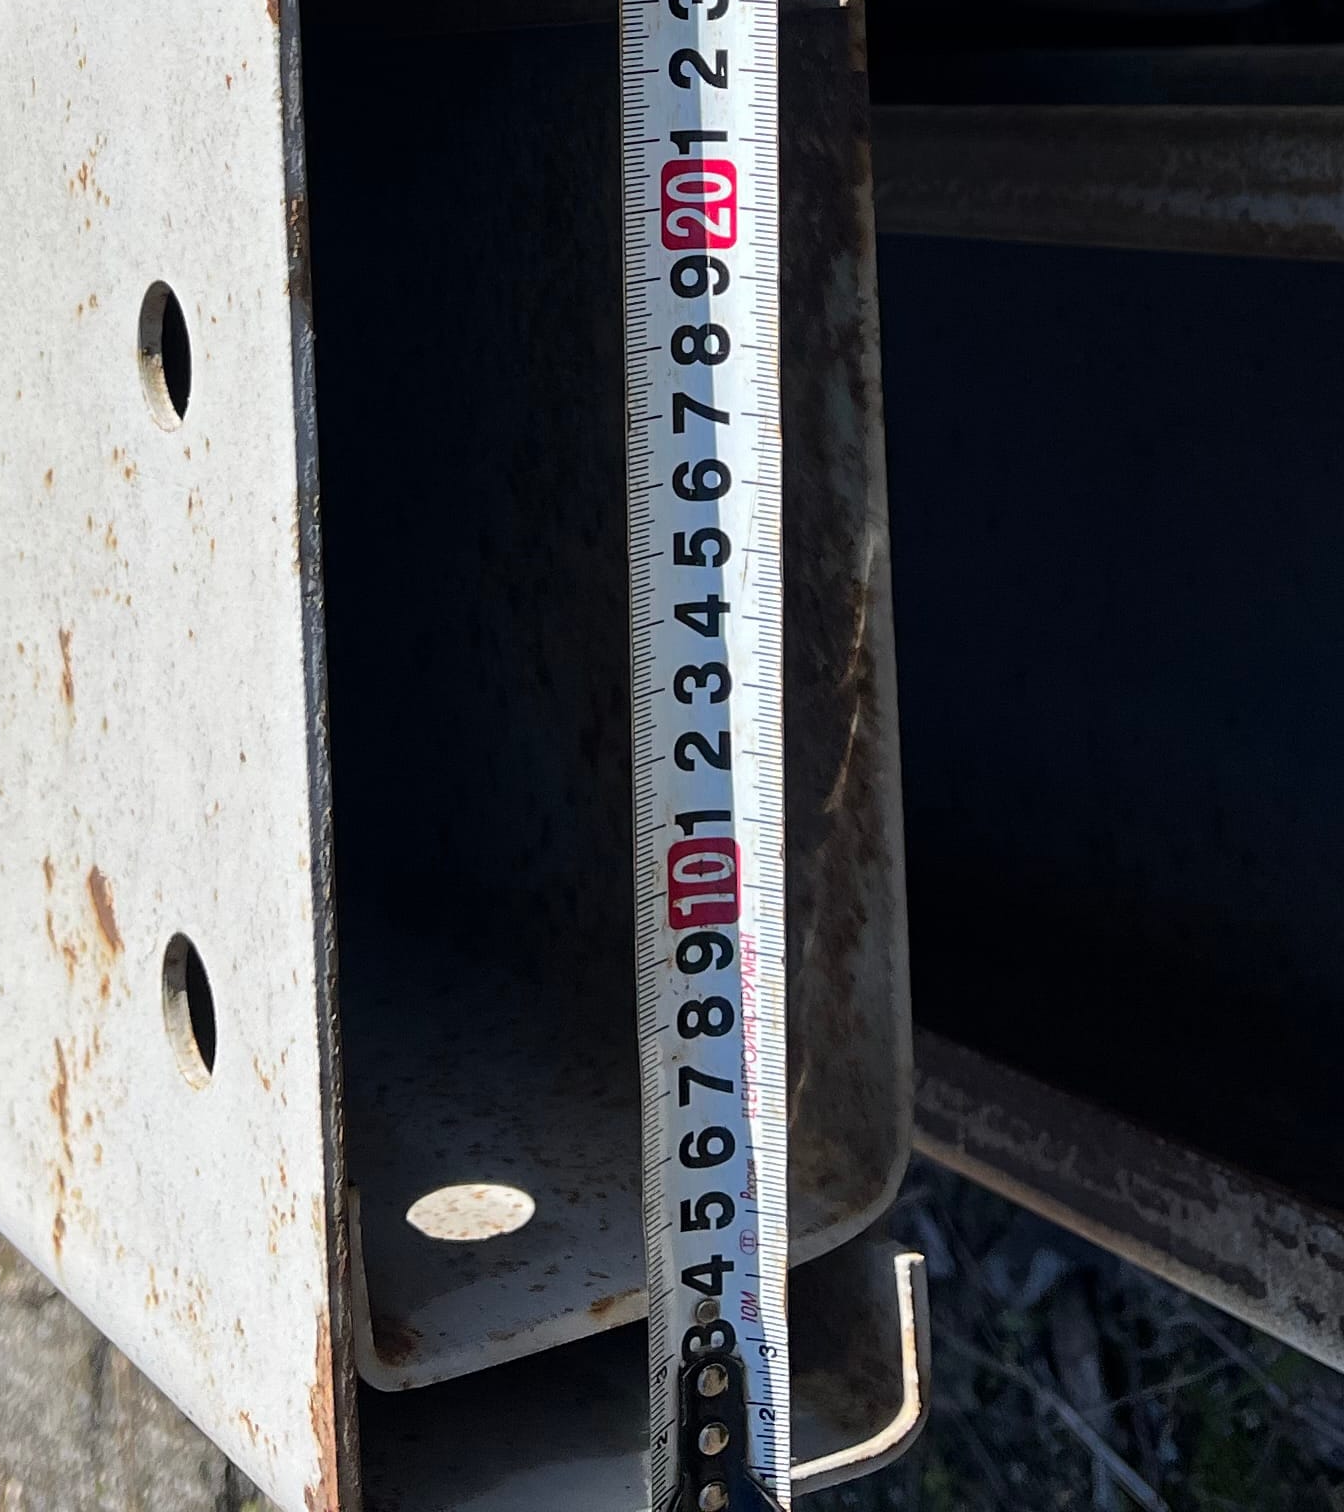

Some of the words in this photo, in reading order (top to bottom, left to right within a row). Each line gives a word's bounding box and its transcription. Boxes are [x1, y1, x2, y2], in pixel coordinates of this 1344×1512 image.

[669, 48, 729, 90] 2
[669, 128, 728, 155] 1
[666, 171, 731, 240] 20
[669, 254, 730, 297] 9
[670, 323, 731, 366] 8
[672, 392, 731, 434] 7
[672, 457, 733, 502] 6
[673, 526, 733, 567] 5
[674, 594, 732, 637] 4
[673, 660, 733, 705] 3
[674, 730, 732, 772] 2
[675, 809, 732, 837] 1
[672, 851, 736, 917] 10
[676, 932, 735, 974] 9
[676, 995, 735, 1038] 8
[678, 1065, 735, 1108] 7
[679, 1125, 736, 1169] 6
[680, 1191, 735, 1233] 5
[681, 1252, 735, 1296] 4
[759, 1345, 777, 1359] 3
[759, 1408, 776, 1421] 2
